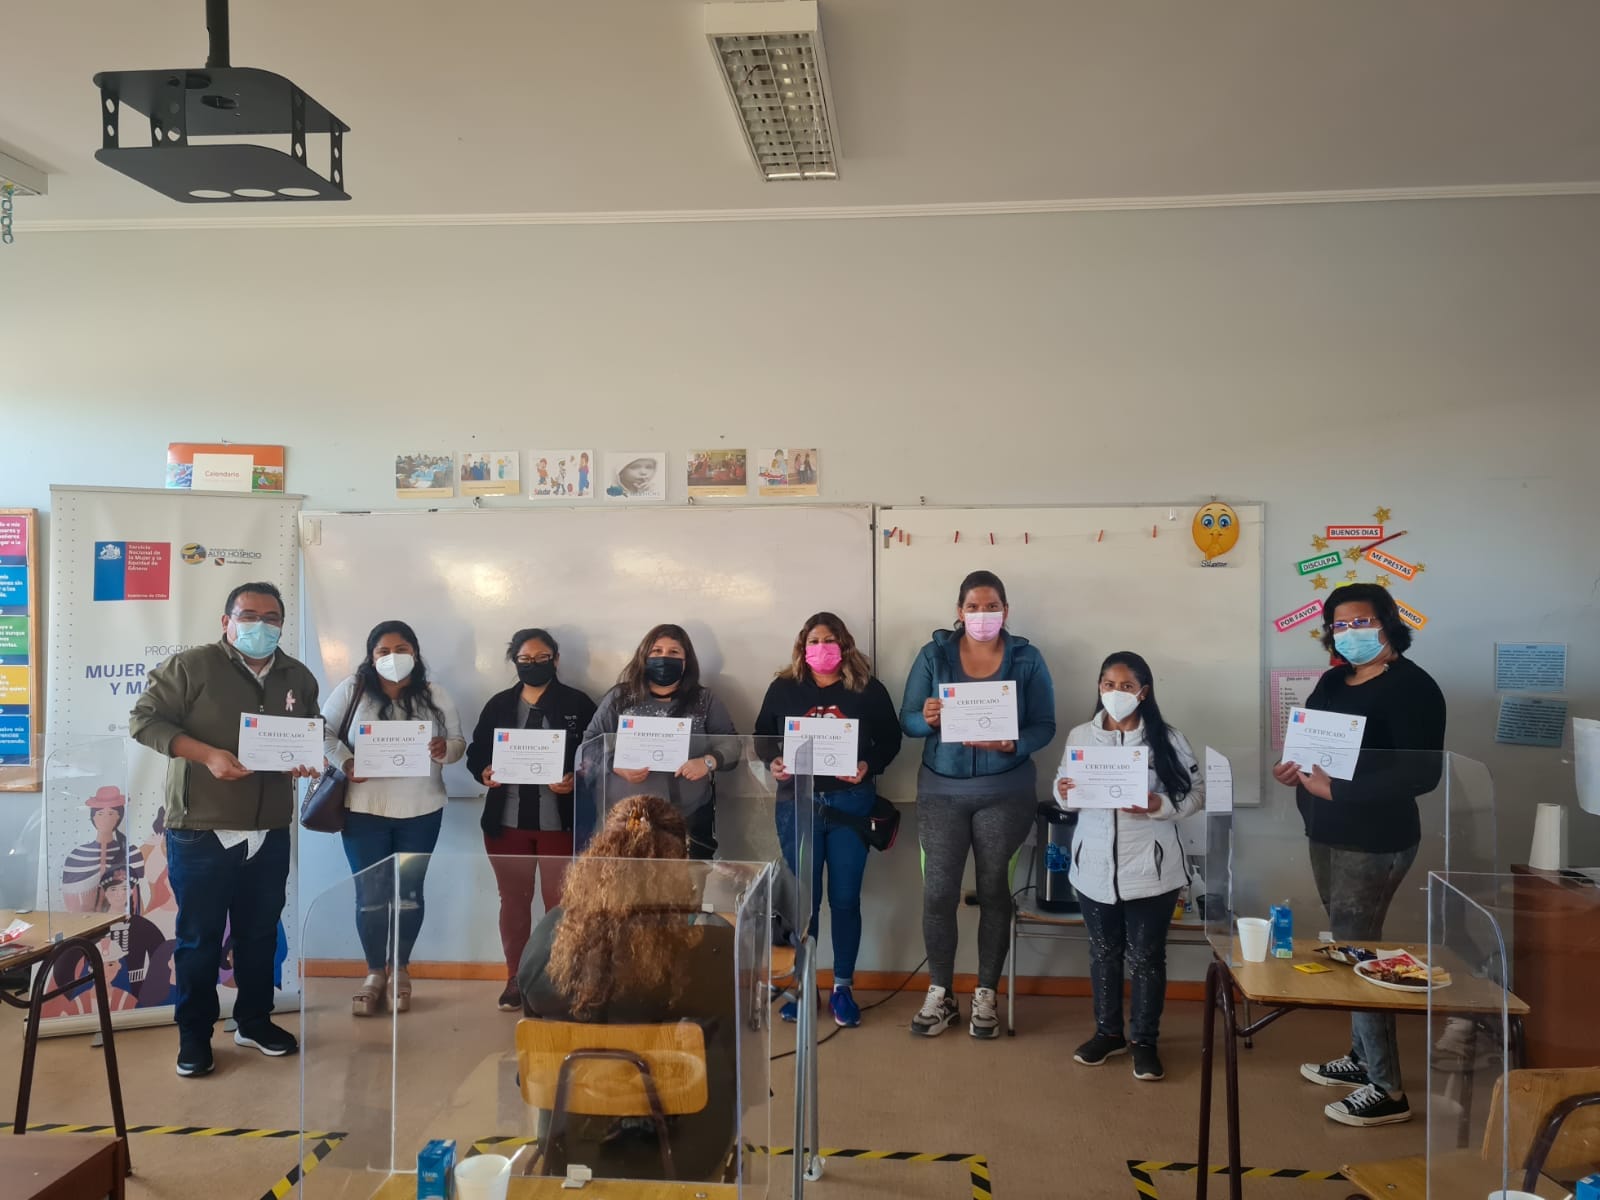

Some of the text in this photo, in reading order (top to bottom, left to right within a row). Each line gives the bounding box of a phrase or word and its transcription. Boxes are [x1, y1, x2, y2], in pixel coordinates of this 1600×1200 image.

[204, 470, 240, 478] Calendario
[1330, 529, 1379, 537] BUENOS DIAS
[228, 551, 262, 559] HOSPICIO
[1303, 556, 1337, 571] DISCULPA
[1371, 552, 1412, 575] ME PRESTAS
[1280, 605, 1318, 628] POR FAVOR
[85, 663, 146, 679] MUJER
[109, 682, 121, 695] Y
[633, 731, 674, 739] CERTIFICADO
[1304, 727, 1346, 738] CERTIFICADO
